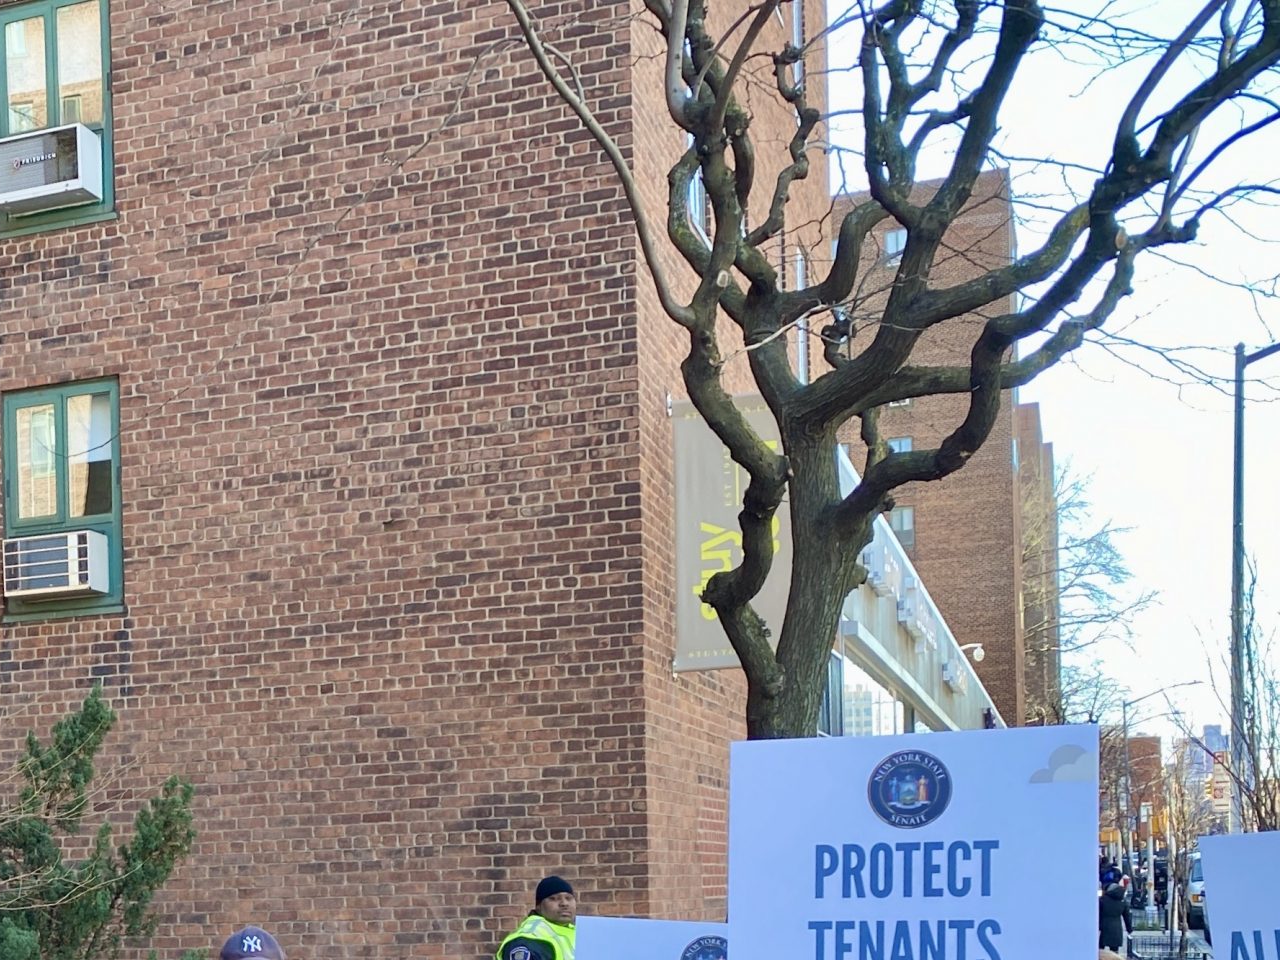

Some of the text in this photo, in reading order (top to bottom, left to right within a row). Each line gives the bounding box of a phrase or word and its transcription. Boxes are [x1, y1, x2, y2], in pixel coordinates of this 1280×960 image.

[892, 753, 922, 764] YORK
[924, 757, 946, 780] STATE
[890, 814, 927, 825] SENATE
[815, 840, 999, 899] PROTECT
